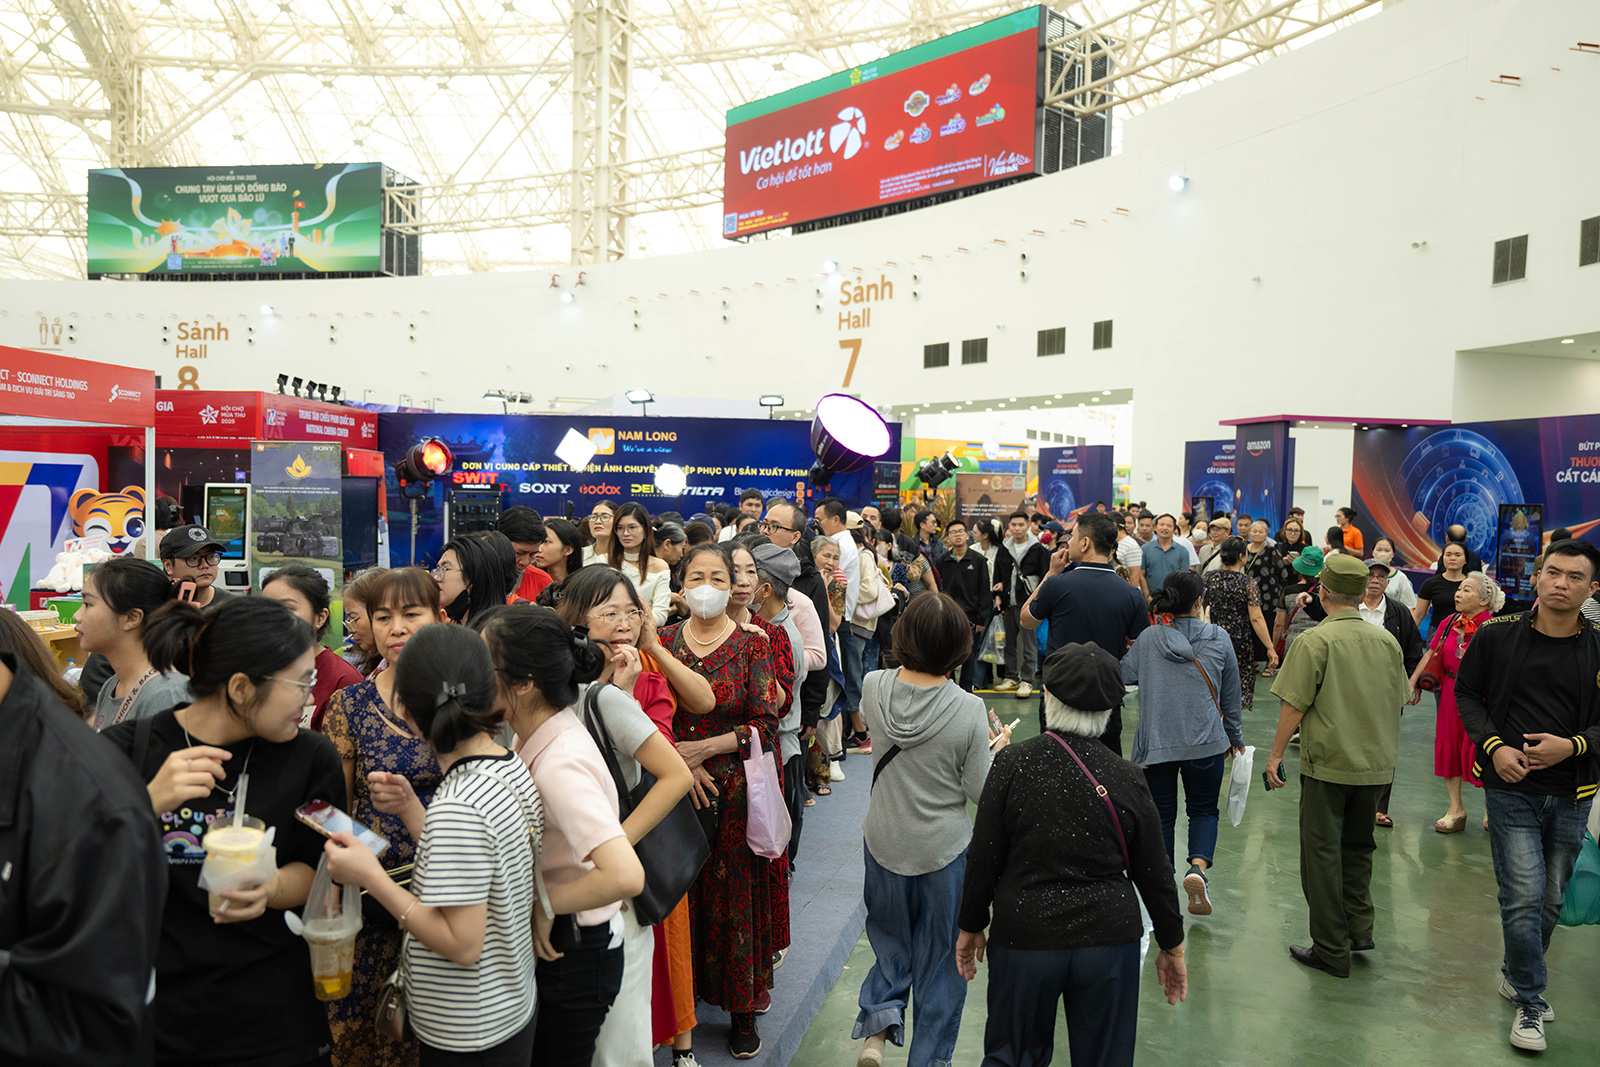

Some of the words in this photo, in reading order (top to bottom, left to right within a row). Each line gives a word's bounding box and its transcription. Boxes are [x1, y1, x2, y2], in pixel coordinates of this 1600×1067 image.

[740, 128, 825, 174] Vietlott
[756, 177, 768, 190] Cơ
[770, 172, 784, 188] hội
[785, 166, 798, 183] để
[798, 164, 812, 180] tốt
[813, 162, 832, 176] hơn
[175, 185, 200, 194] CHUNG
[202, 184, 215, 193] TAY
[217, 183, 232, 193] ỨNG
[234, 182, 246, 193] HỘ
[199, 194, 219, 204] VƯỢT
[220, 194, 236, 203] QUA
[840, 274, 893, 306] Sảnh
[838, 308, 870, 330] Hall
[177, 320, 228, 340] Sảnh
[176, 344, 207, 358] Hall
[838, 338, 862, 388] 7
[17, 372, 54, 386] SCONNECT
[54, 377, 88, 391] HOLDINGS
[177, 366, 200, 390] 8
[12, 384, 24, 394] DỊCH
[25, 386, 33, 395] VỤ
[34, 386, 44, 396] GIẢI
[52, 388, 65, 398] SÁNG
[66, 391, 76, 400] TẠO
[118, 389, 142, 398] SCONNECT
[156, 401, 174, 412] GIA
[299, 409, 311, 420] TRUNG
[320, 411, 330, 422] CHIẾU
[330, 414, 339, 424] PHIM
[339, 414, 349, 425] QUỐC
[306, 424, 323, 434] NATIONAL
[324, 426, 336, 436] CINEMA
[337, 428, 349, 437] CENTER
[618, 432, 643, 441] NAM
[645, 432, 677, 442] LONG
[1247, 440, 1271, 450] amazon
[1578, 440, 1594, 451] BỨT
[462, 462, 482, 470] ĐƠN
[484, 462, 494, 472] VỊ
[495, 463, 520, 471] CUNG
[522, 462, 541, 471] CẤP
[542, 462, 568, 472] THIẾT
[584, 463, 601, 474] IỆN
[603, 462, 622, 472] ẢNH
[1570, 456, 1600, 467] THƯƠ
[453, 472, 499, 484] SWIT
[697, 467, 722, 476] PHỤC
[724, 468, 737, 476] VỤ
[738, 466, 757, 476] SẢN
[759, 467, 783, 476] XUẤT
[785, 469, 808, 477] PHIM
[1556, 468, 1580, 483] CẤT
[519, 483, 571, 493] SONY
[631, 484, 660, 494] DEI
[682, 487, 725, 496] TILTA
